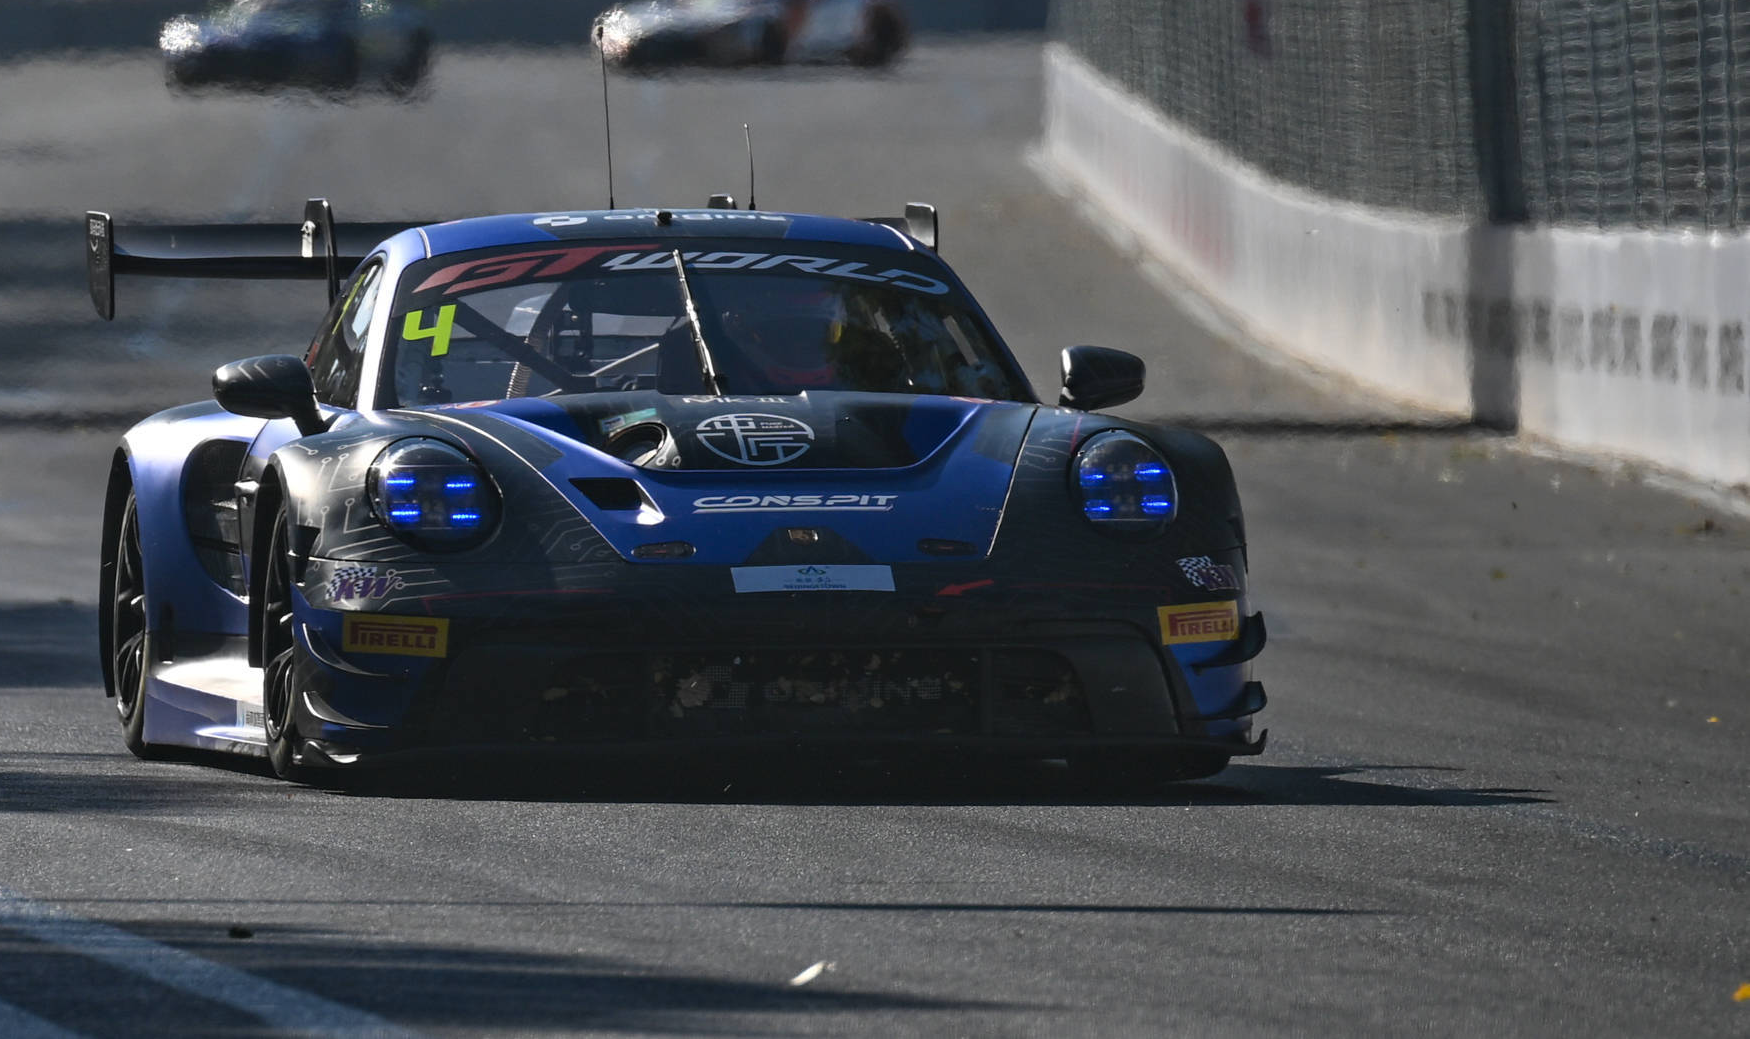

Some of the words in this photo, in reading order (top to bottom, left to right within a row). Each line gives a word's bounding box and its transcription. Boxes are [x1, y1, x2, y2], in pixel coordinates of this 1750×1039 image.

[402, 304, 457, 357] 4
[692, 495, 899, 509] CONSPIT
[333, 576, 403, 603] KW
[351, 621, 439, 650] PIRELLI
[1167, 608, 1235, 638] PIRELLI
